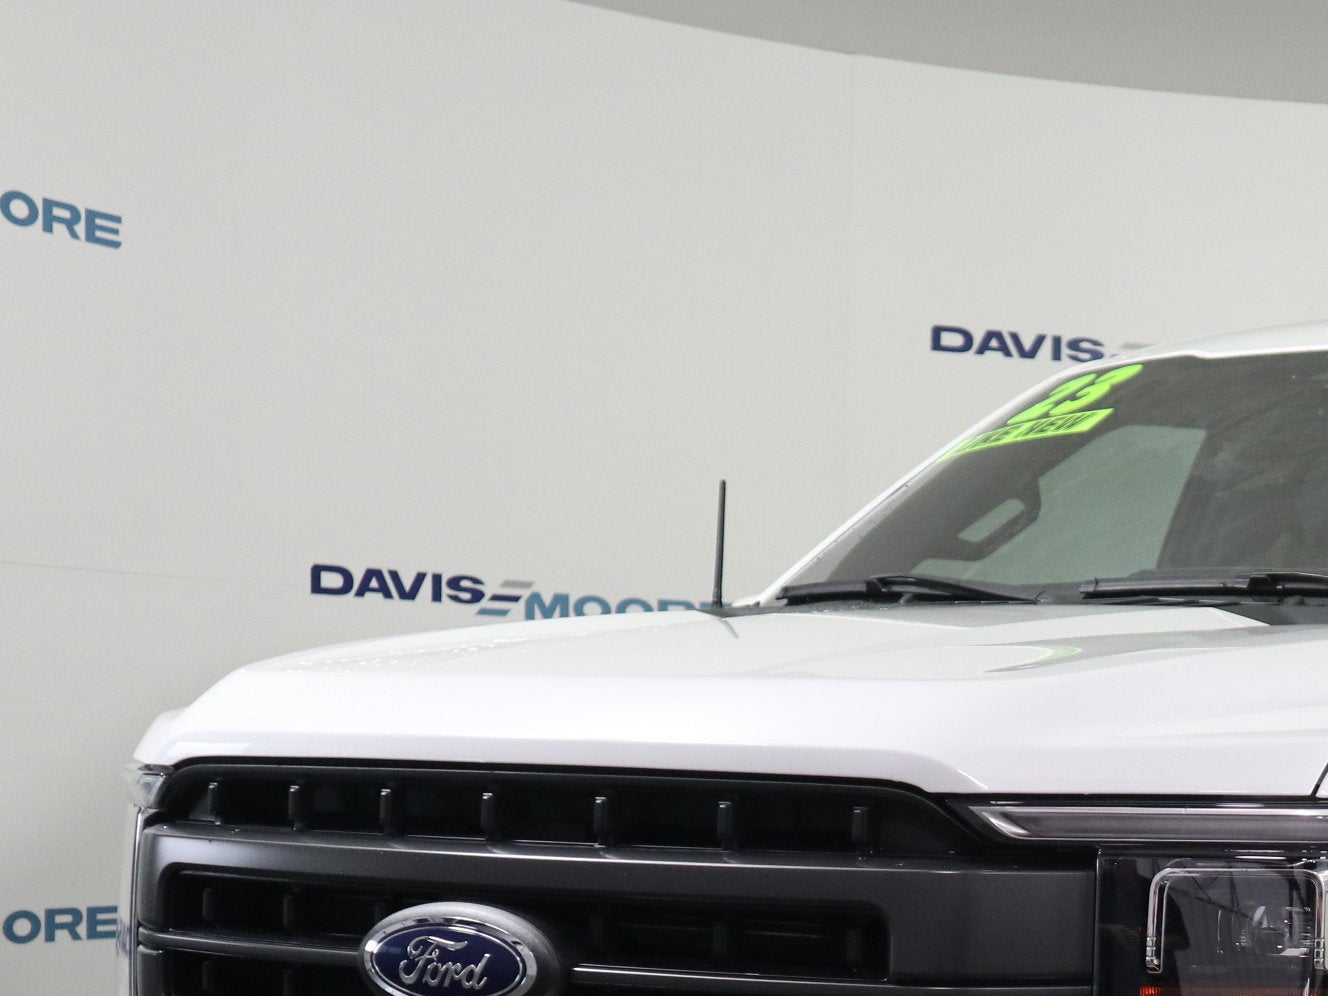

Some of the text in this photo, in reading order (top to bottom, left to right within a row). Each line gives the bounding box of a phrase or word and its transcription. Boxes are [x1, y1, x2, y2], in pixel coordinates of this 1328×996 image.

[931, 325, 1105, 362] DAVIS
[1018, 411, 1097, 439] NEW
[310, 563, 486, 606] DAVIS
[399, 935, 492, 991] Ford
